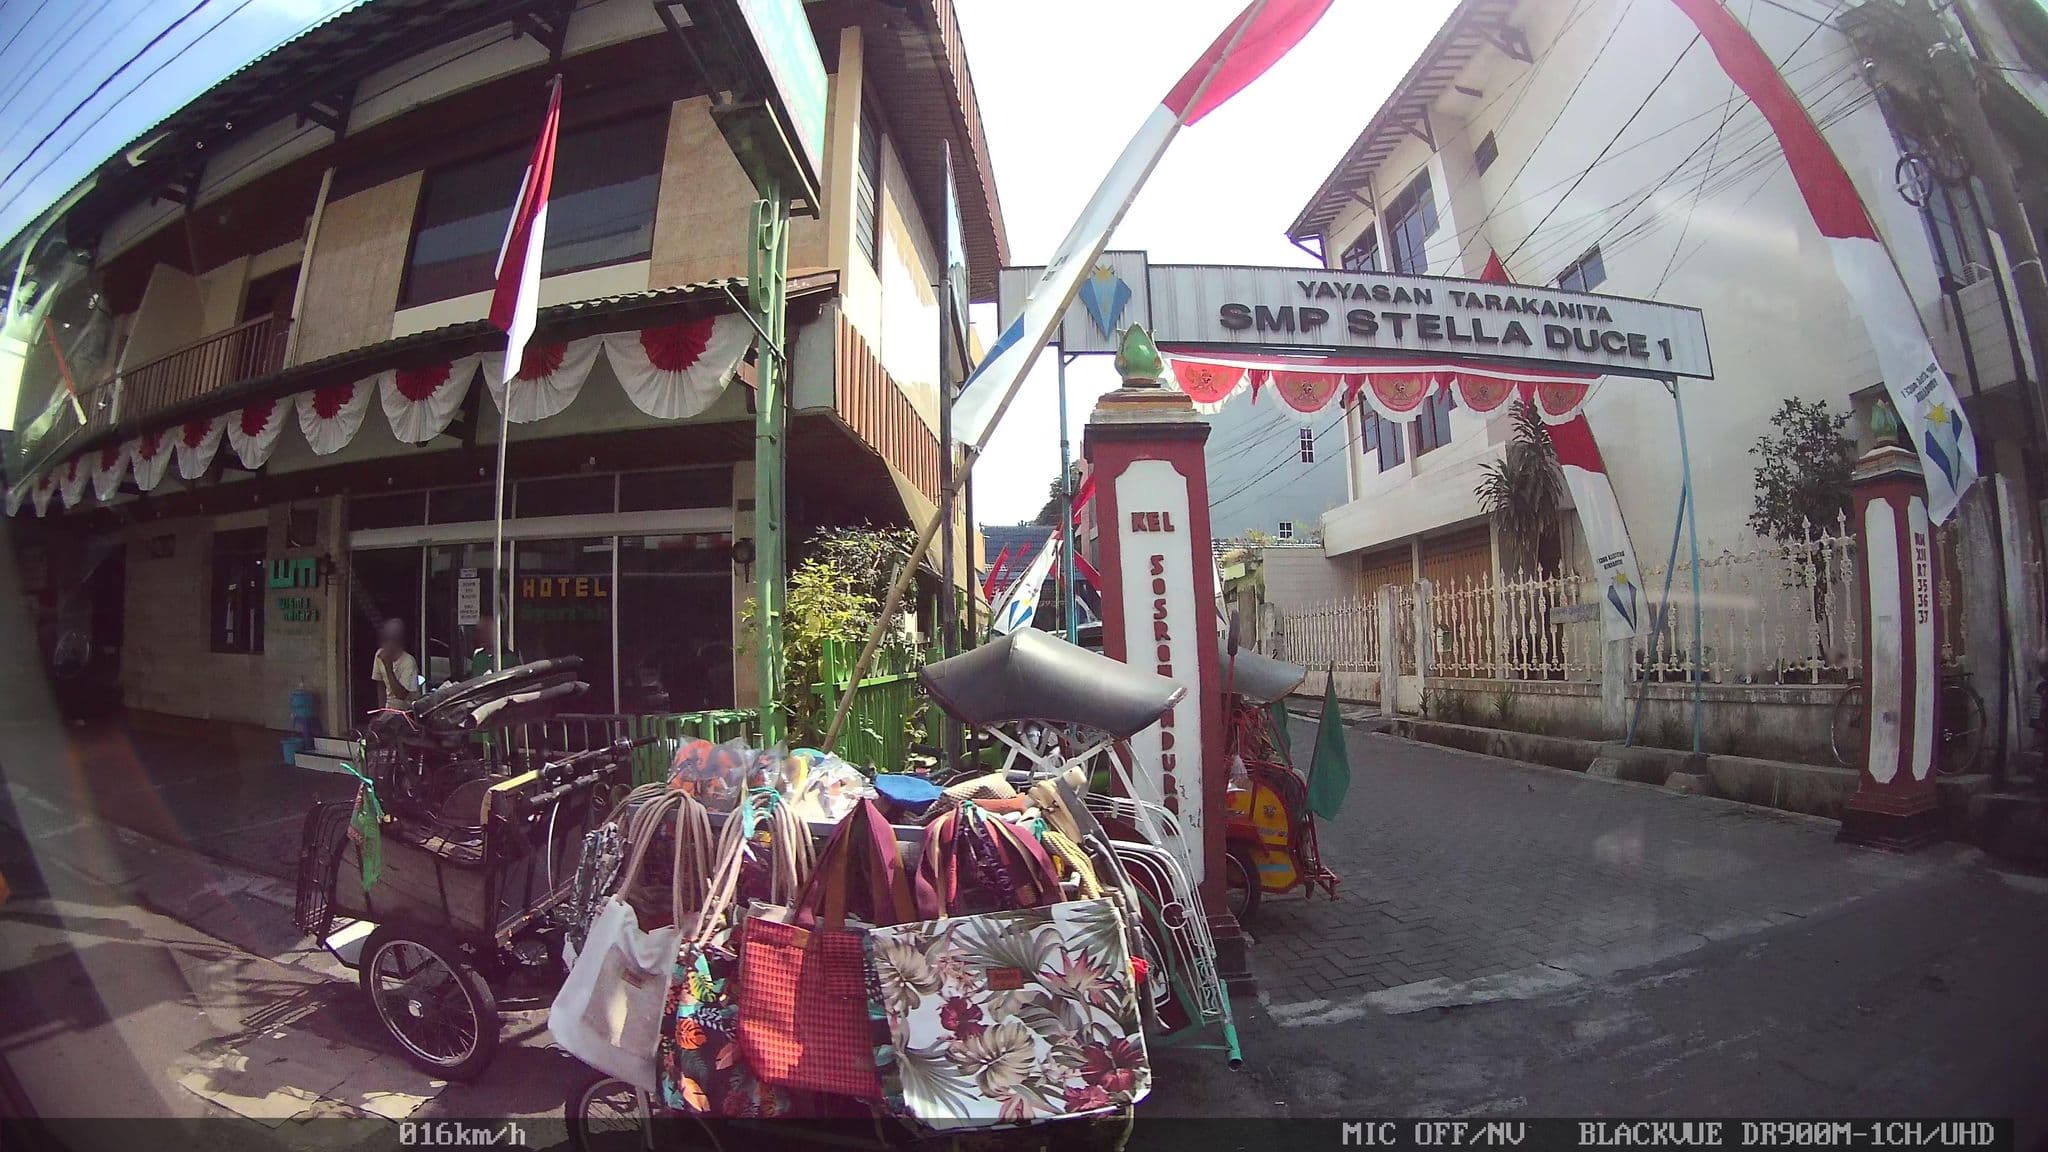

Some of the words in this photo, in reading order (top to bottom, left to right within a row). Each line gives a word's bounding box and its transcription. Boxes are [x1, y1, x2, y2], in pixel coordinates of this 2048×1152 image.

[1297, 281, 1432, 304] YAYASAN
[1449, 290, 1613, 323] TARAKANITA
[1220, 303, 1329, 332] SMP
[1347, 309, 1533, 346] STELLA
[1544, 324, 1650, 358] DUCE
[1658, 338, 1673, 361] 1
[1131, 511, 1175, 532] KEL
[523, 577, 607, 598] HOTEL
[1918, 579, 1928, 592] 35
[1918, 610, 1929, 624] 37
[1150, 554, 1179, 836] SOSRONDURA
